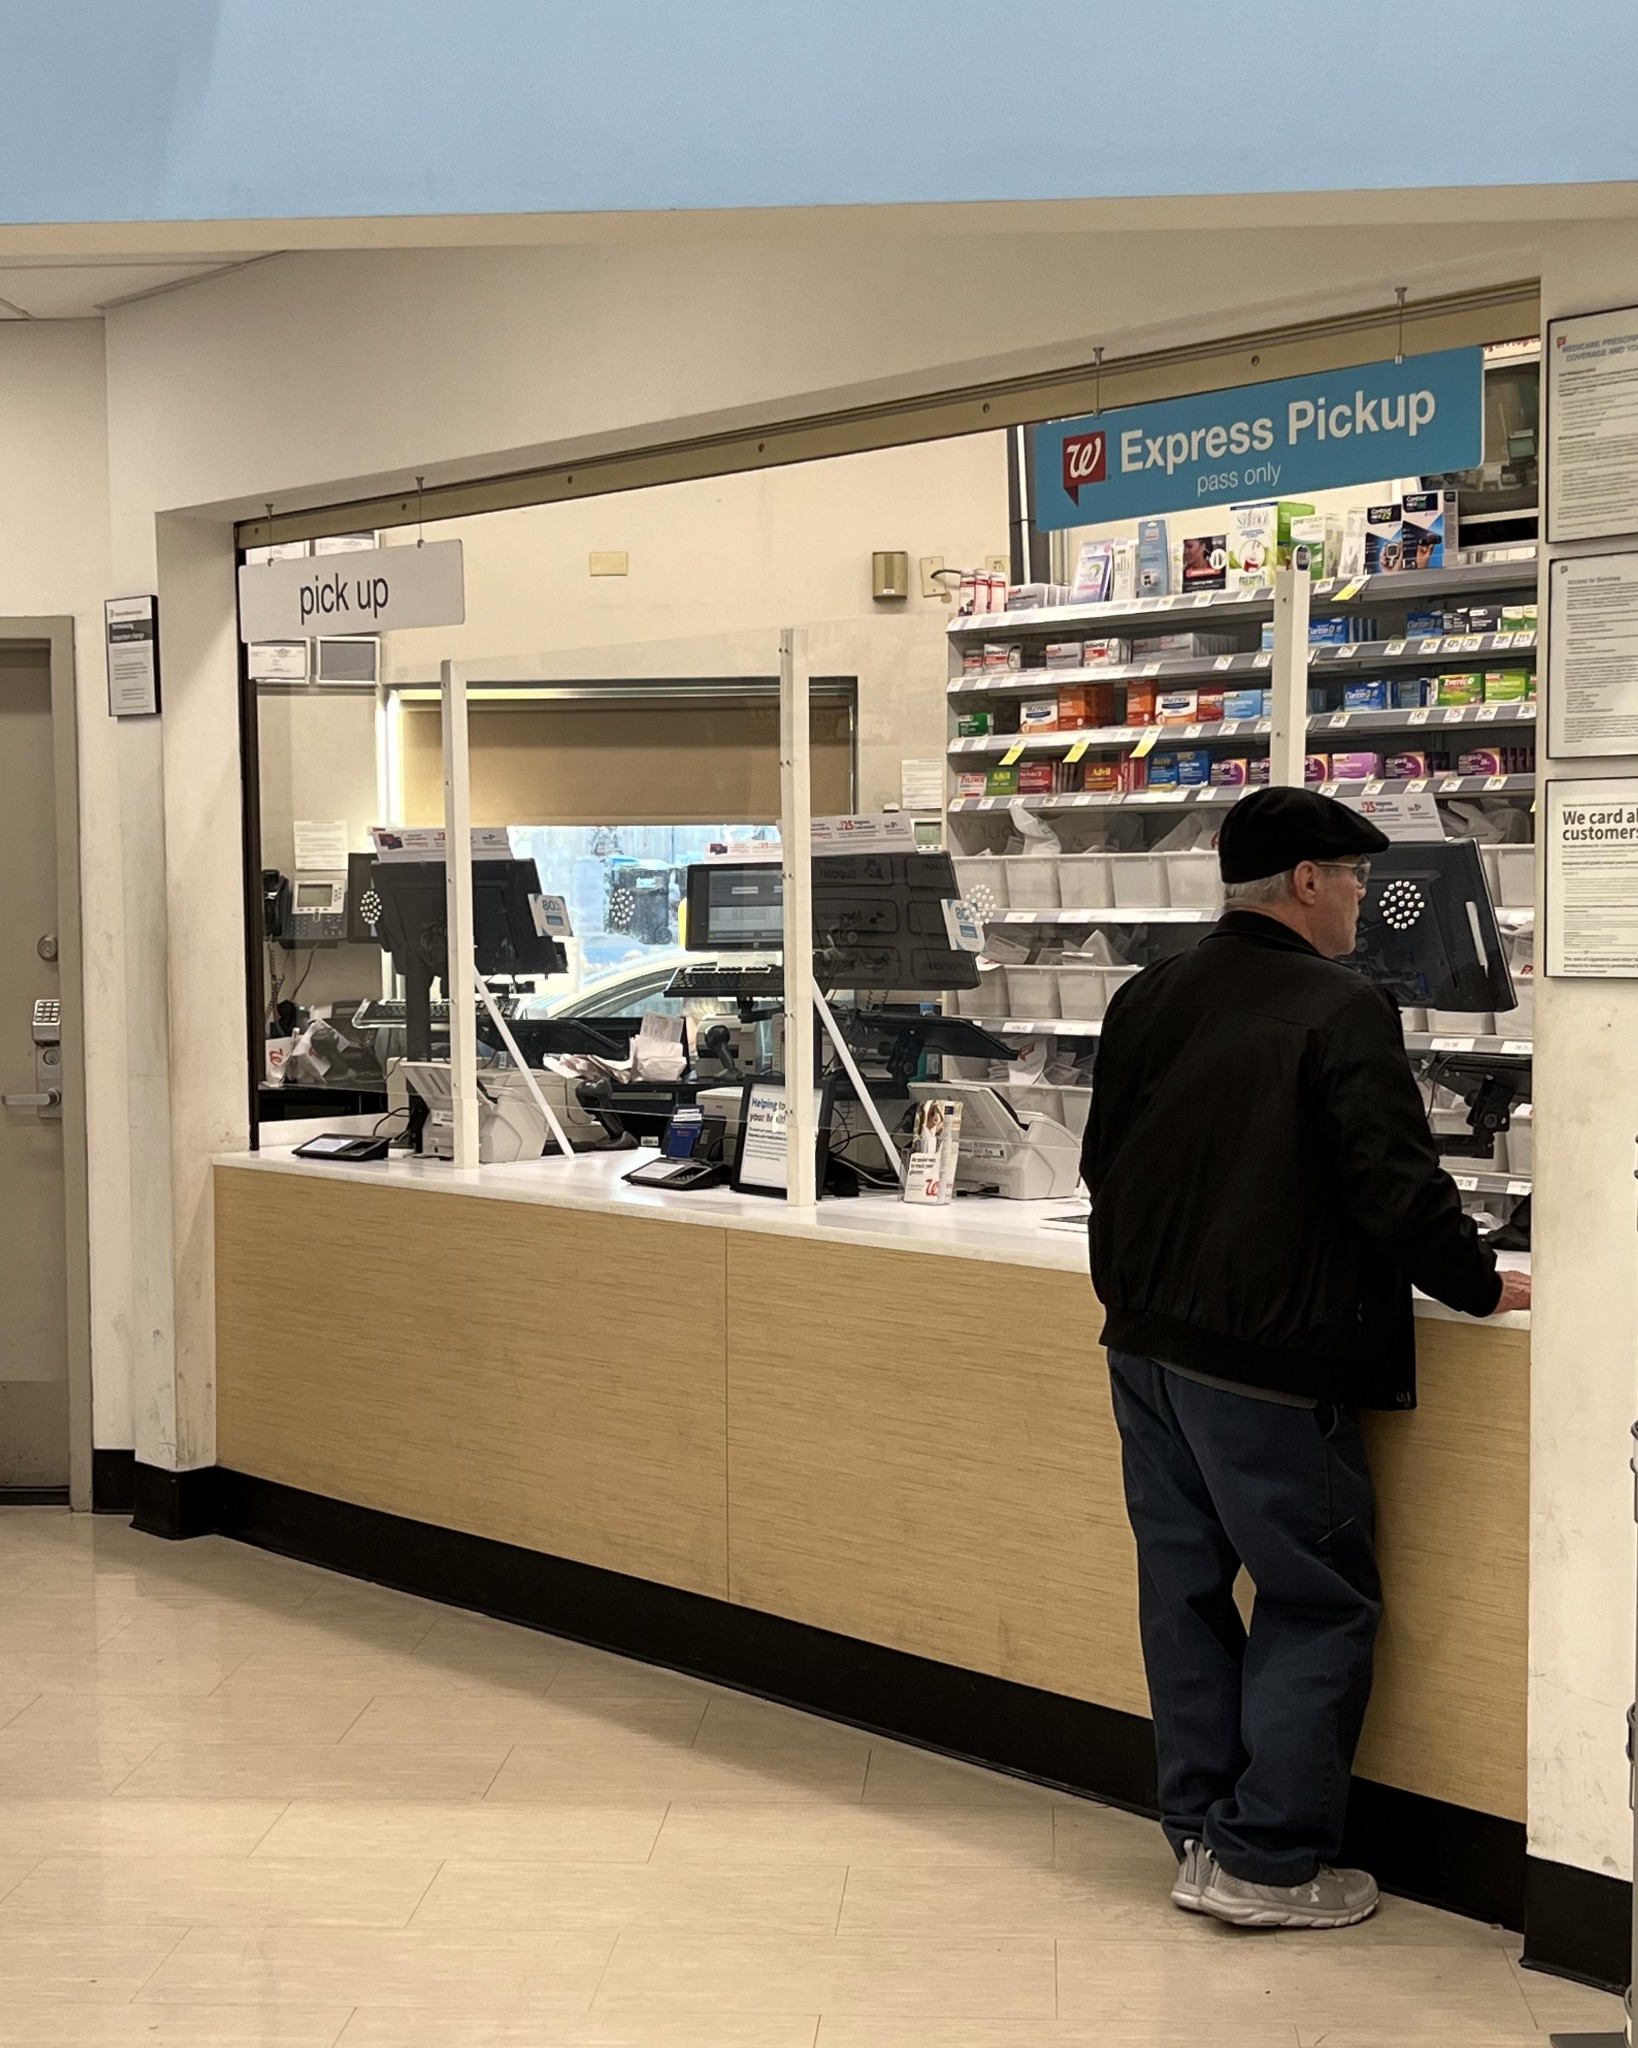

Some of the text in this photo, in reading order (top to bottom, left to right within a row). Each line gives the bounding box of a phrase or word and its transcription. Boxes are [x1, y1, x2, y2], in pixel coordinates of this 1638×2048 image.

[1121, 416, 1273, 476] Express
[1288, 389, 1436, 446] Pickup
[1197, 461, 1281, 497] pass only
[300, 572, 388, 625] pick up
[1562, 810, 1586, 825] We
[1589, 808, 1623, 825] card
[751, 1097, 777, 1112] Helping
